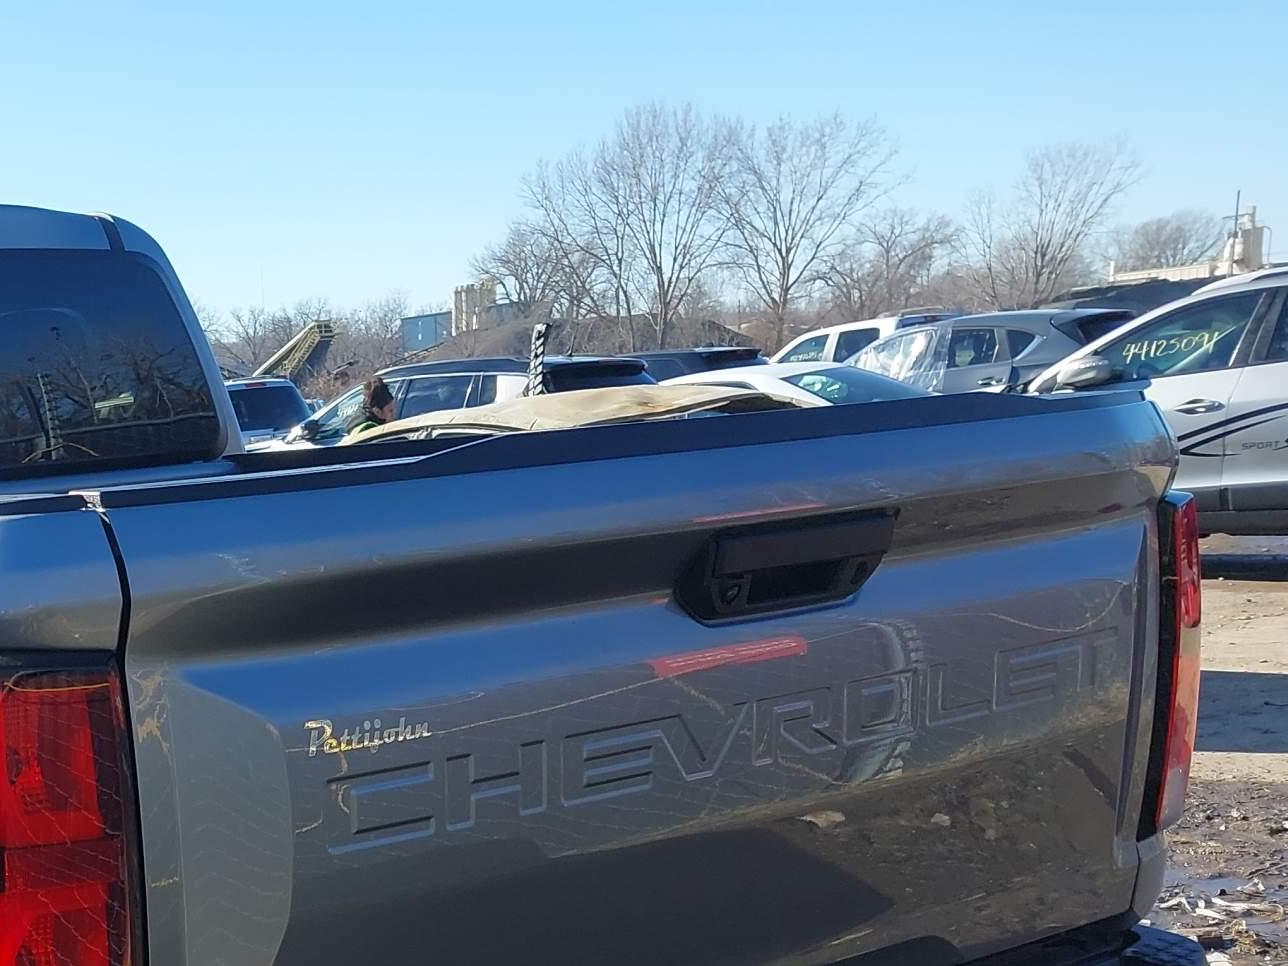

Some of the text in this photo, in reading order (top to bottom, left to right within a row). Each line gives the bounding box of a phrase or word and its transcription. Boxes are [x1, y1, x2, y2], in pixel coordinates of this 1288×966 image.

[1242, 440, 1281, 451] SPORT
[304, 716, 433, 757] Pettijohn
[325, 625, 1119, 856] CHEVROLET
